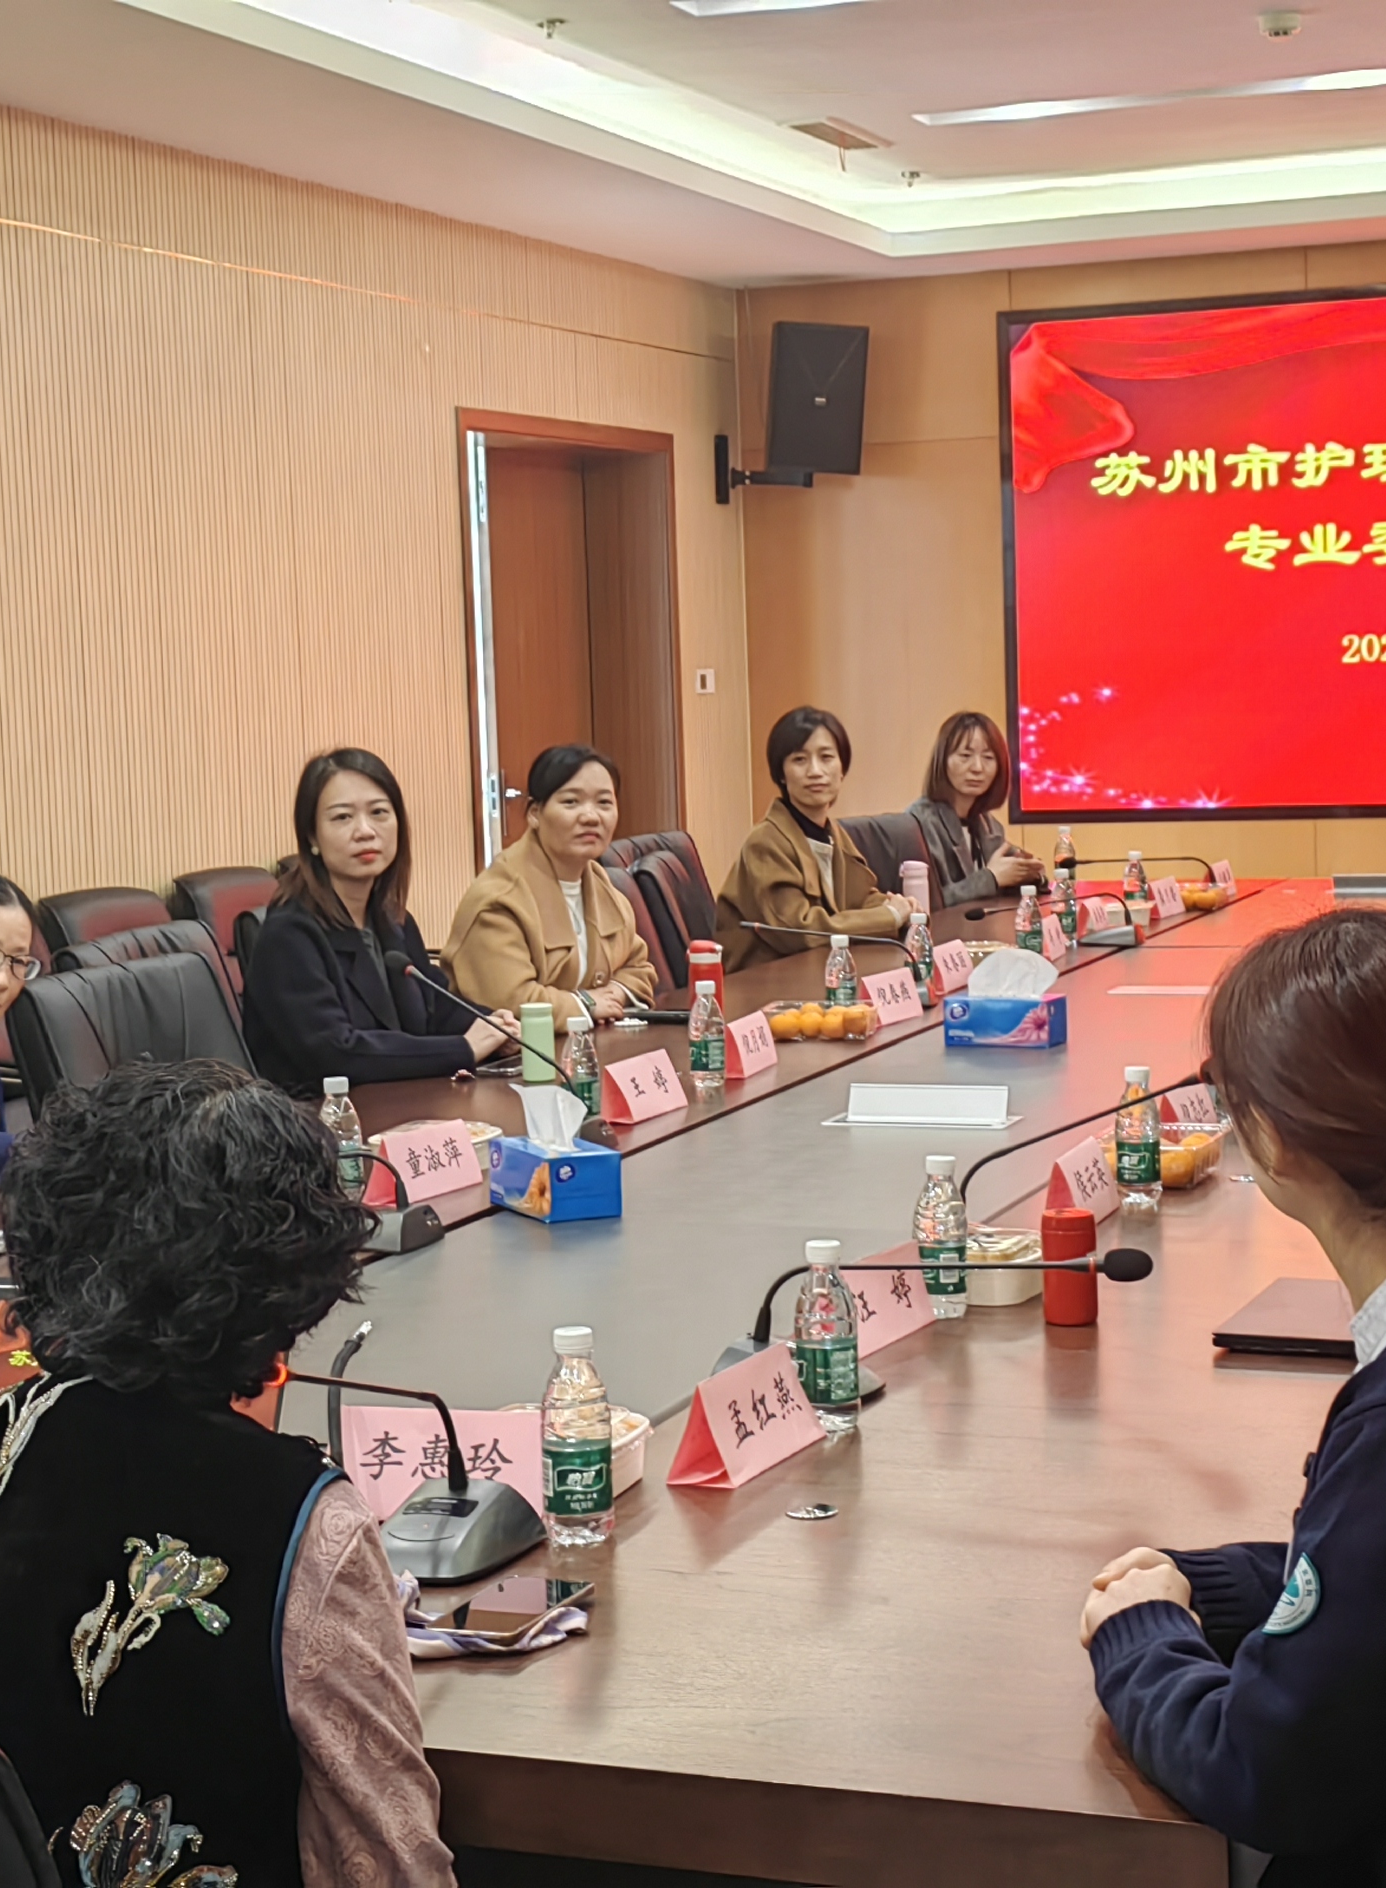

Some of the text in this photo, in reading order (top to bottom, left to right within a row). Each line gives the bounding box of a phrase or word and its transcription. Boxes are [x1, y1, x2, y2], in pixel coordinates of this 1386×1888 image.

[406, 1136, 463, 1179] 童淑萍
[728, 1371, 803, 1449] 孟红燕
[359, 1431, 513, 1482] 李惠玲
